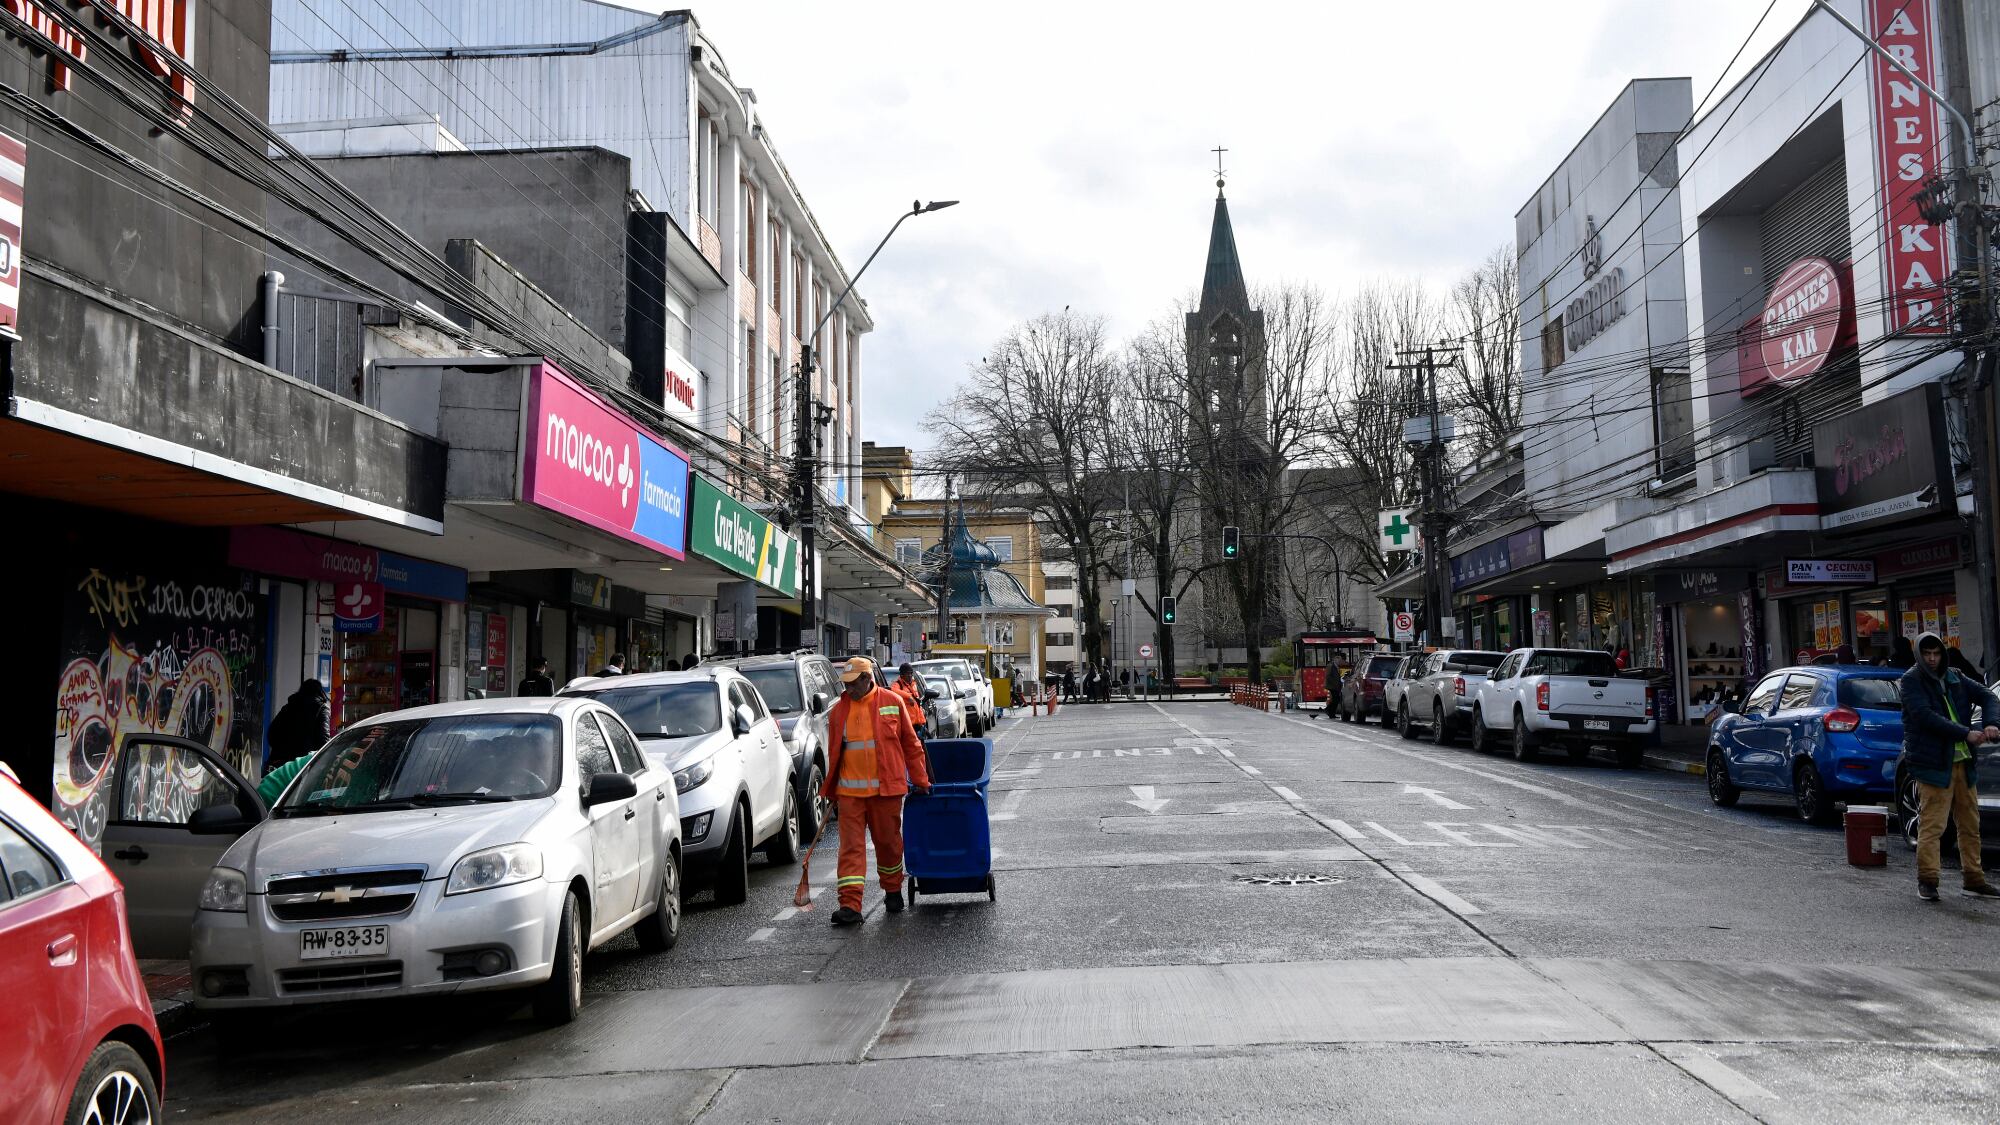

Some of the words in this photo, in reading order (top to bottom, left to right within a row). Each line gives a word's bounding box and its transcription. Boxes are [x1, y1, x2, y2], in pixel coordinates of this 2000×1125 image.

[1899, 223, 1941, 327] KAR
[1763, 272, 1829, 334] CARNES
[1781, 325, 1818, 369] KAR
[547, 412, 614, 488] maicao
[643, 472, 681, 518] farmacia
[715, 499, 734, 551] Cruz
[733, 511, 756, 565] Verde
[322, 551, 361, 575] maicao
[1791, 563, 1813, 572] PAN
[1825, 563, 1873, 572] CECINAS
[320, 637, 332, 650] 353
[340, 621, 373, 629] farmacia
